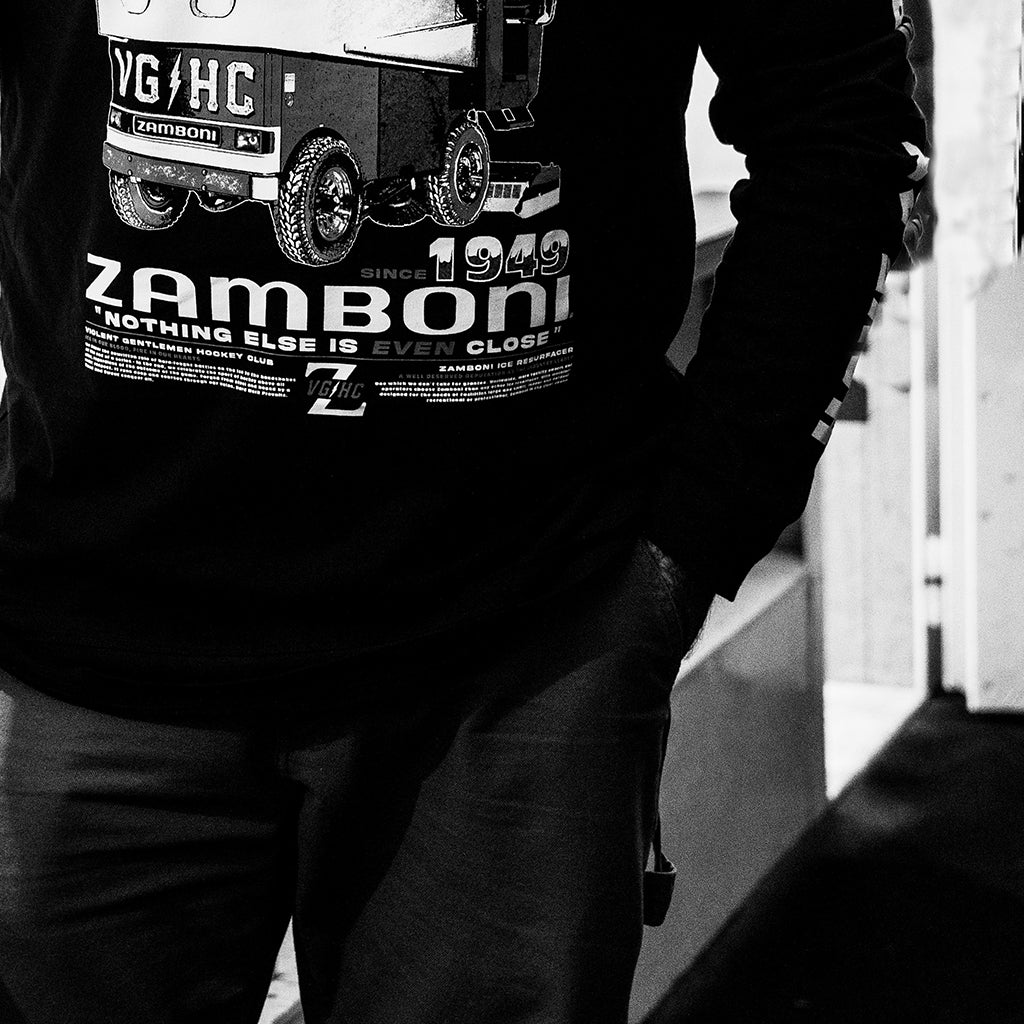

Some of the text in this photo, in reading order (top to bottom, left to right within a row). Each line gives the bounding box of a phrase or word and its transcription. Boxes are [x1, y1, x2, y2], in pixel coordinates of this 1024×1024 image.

[137, 120, 218, 142] ZAMBONI
[360, 229, 570, 282] SINCE 1949
[86, 252, 570, 335] ZAMBONI
[85, 326, 119, 342] VIOLENT
[122, 338, 192, 354] GENTLEMEN
[196, 348, 243, 360] HOCKEY
[247, 355, 274, 366] CLUB
[244, 330, 316, 352] ELSE
[330, 338, 358, 353] IS
[372, 340, 456, 356] EVEN
[516, 347, 574, 366] RESURFACER
[305, 362, 367, 417] Z
